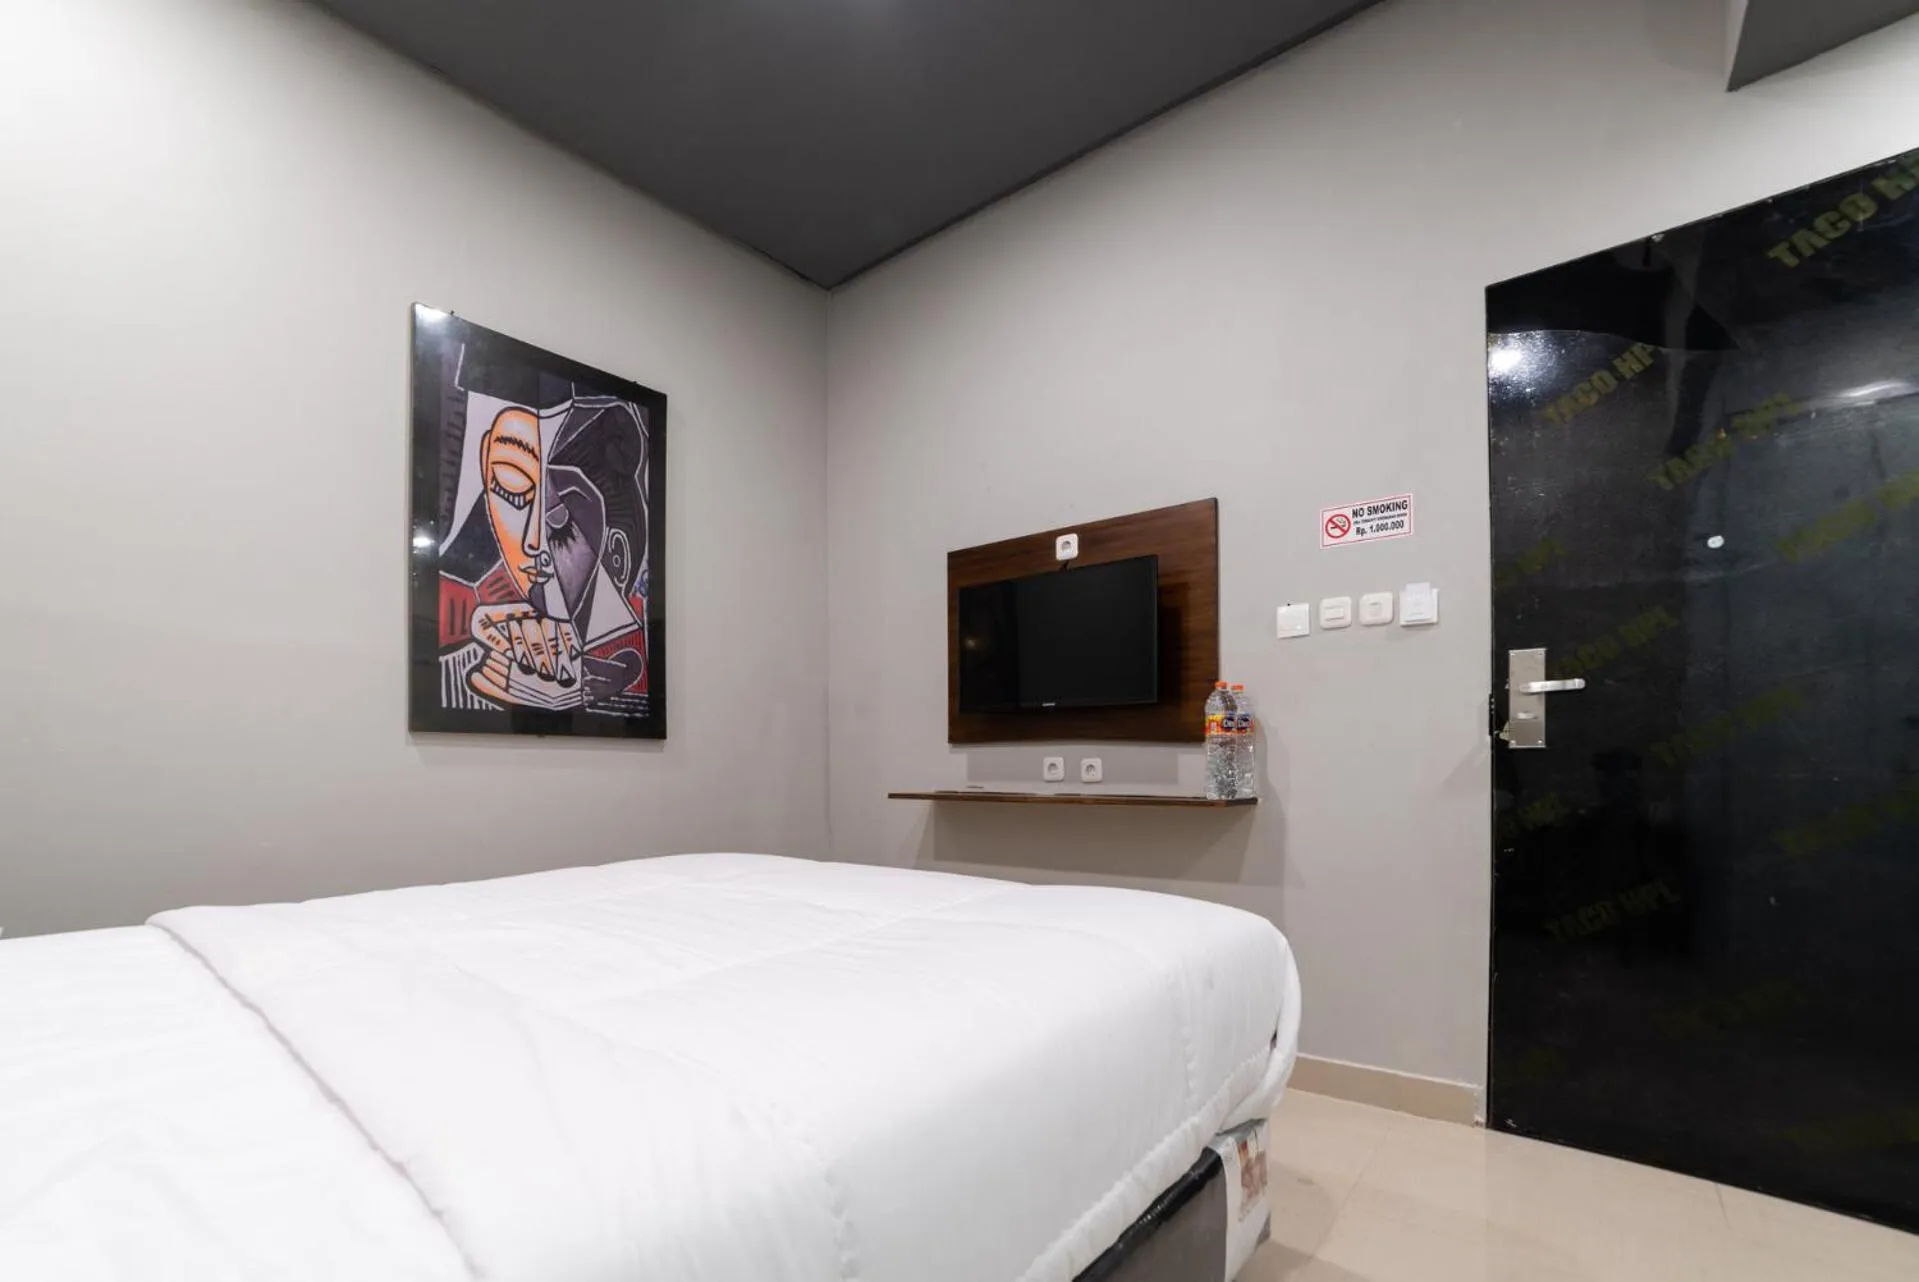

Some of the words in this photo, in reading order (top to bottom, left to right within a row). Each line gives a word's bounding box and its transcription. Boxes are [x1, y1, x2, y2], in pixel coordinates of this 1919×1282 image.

[1767, 191, 1878, 268] TACO
[1352, 507, 1364, 518] NO
[1367, 499, 1408, 516] SMOKING
[1370, 519, 1404, 533] 1.000.000
